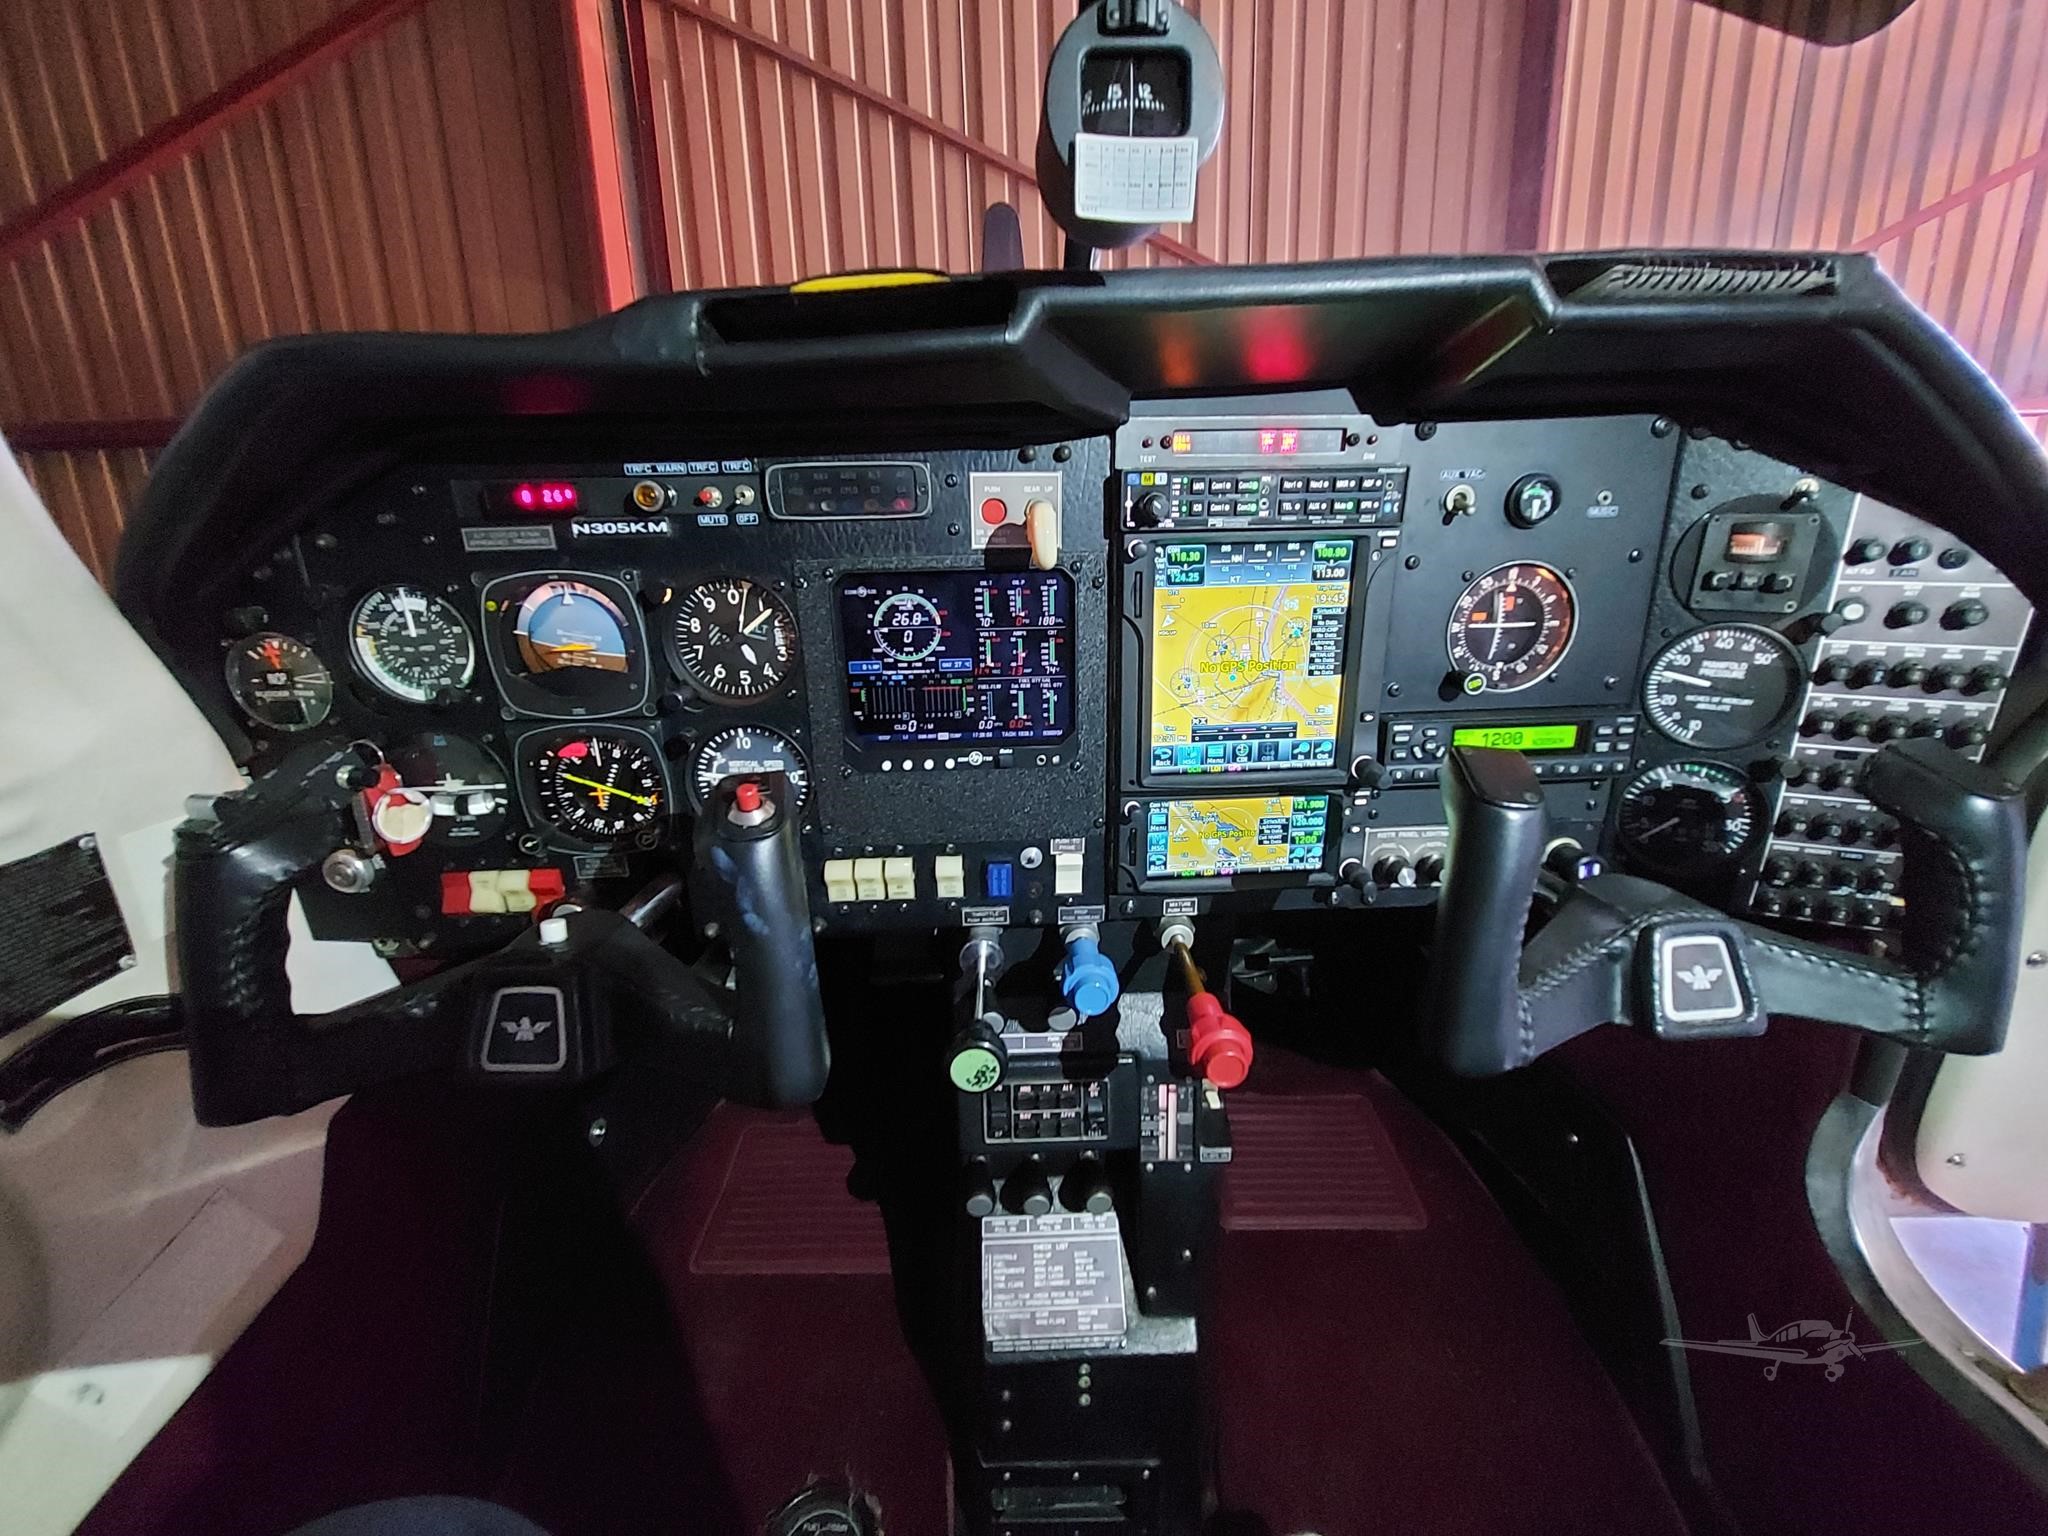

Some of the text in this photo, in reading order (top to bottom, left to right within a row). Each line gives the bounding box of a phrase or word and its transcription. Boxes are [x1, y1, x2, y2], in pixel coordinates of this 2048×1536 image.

[1107, 83, 1122, 99] 15
[1138, 82, 1153, 100] 12
[656, 463, 685, 473] WARN
[984, 485, 1001, 493] PUSH
[1044, 485, 1054, 493] UP
[700, 515, 727, 525] MUTE
[738, 514, 756, 524] OFF
[572, 521, 669, 534] N305KM
[1171, 551, 1201, 562] 118.30
[1171, 572, 1200, 582] 124.25
[1316, 568, 1345, 579] 113.00
[728, 588, 740, 605] 0
[1315, 593, 1345, 604] 19+45
[703, 597, 716, 612] 9
[690, 617, 701, 632] 8
[774, 612, 784, 626] 2
[892, 612, 922, 626] 26.8
[903, 630, 913, 643] 0
[1715, 638, 1734, 649] 40
[693, 644, 704, 659] 7
[776, 647, 789, 661] 3
[1672, 654, 1691, 666] 30
[1701, 660, 1749, 670] MANIFOLD
[1753, 653, 1772, 665] 50
[714, 663, 726, 678] 6
[762, 663, 774, 677] 4
[1200, 660, 1297, 673] No GPS Position
[739, 670, 752, 685] 5
[1698, 669, 1747, 679] PRESSURE
[1660, 695, 1677, 706] 20
[908, 720, 917, 732] 0
[978, 720, 994, 729] 0.0
[1688, 720, 1703, 730] 10
[736, 737, 751, 749] 10
[1482, 732, 1523, 746] 1200
[1295, 835, 1318, 845] 1200
[1055, 1242, 1069, 1250] LIST
